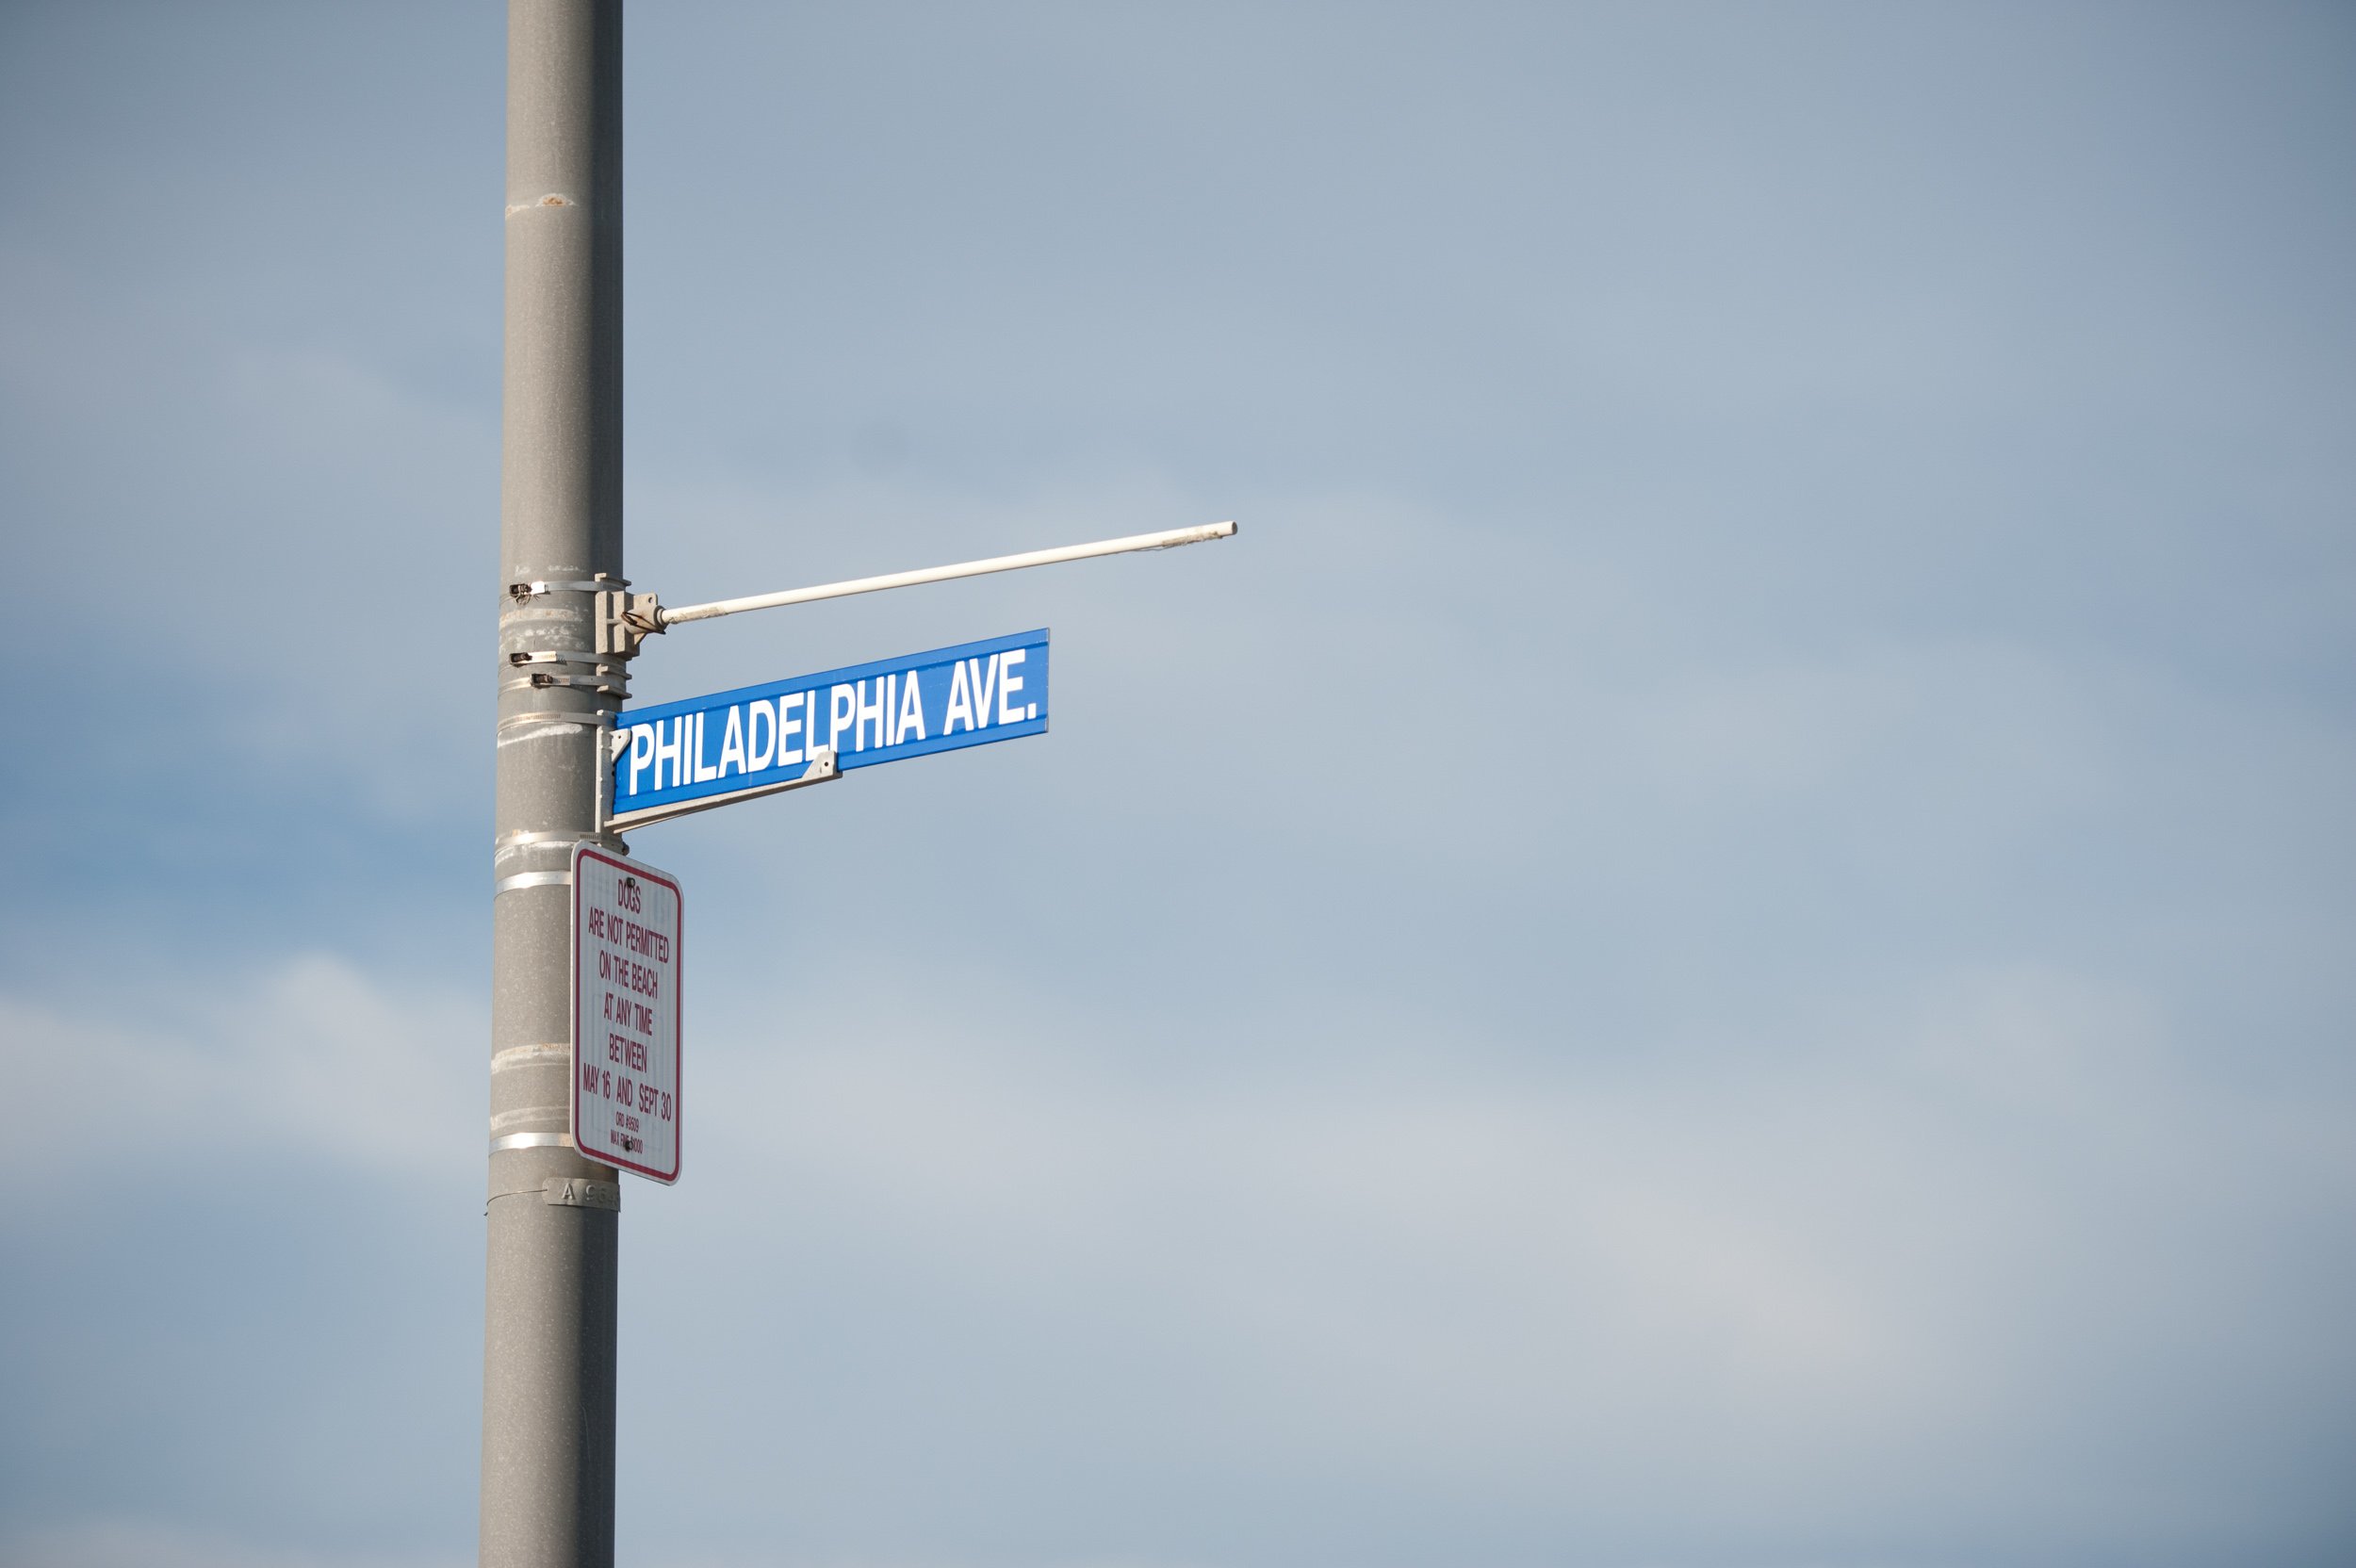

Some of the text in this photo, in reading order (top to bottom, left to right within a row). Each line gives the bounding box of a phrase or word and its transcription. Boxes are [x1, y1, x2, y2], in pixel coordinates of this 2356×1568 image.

[630, 648, 1037, 795] PHILADELPHIA AVE.
[618, 878, 641, 914] DOGS
[588, 906, 670, 964] ARE NOT PERMITTED
[599, 950, 658, 999] ON THE BEACH
[604, 992, 653, 1036] AT ANY TIME
[609, 1033, 647, 1073] BETWEEN
[583, 1063, 672, 1121] MAY 16 AND SEPT 30
[611, 1129, 619, 1146] MAX
